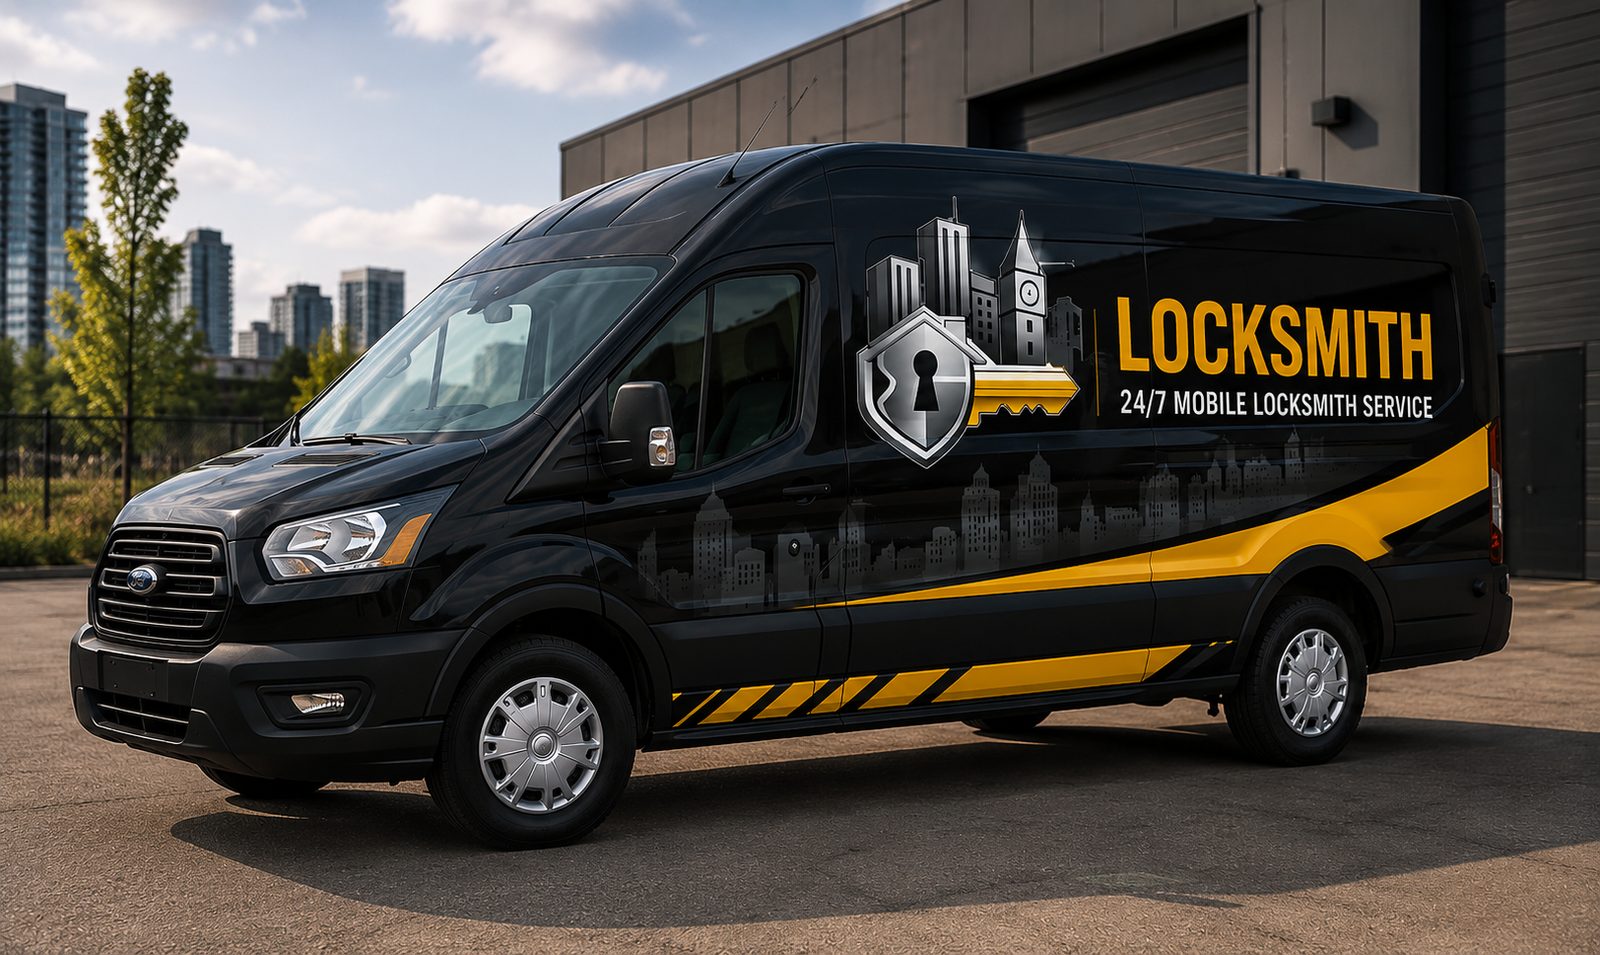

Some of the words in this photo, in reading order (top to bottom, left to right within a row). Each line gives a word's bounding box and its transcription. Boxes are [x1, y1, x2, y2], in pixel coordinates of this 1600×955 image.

[1117, 296, 1434, 381] LOCKSMITH
[1120, 388, 1167, 419] 24/7
[1173, 390, 1248, 416] MOBILE
[1253, 391, 1357, 418] LOCKSMITH
[1362, 394, 1434, 419] SERVICE
